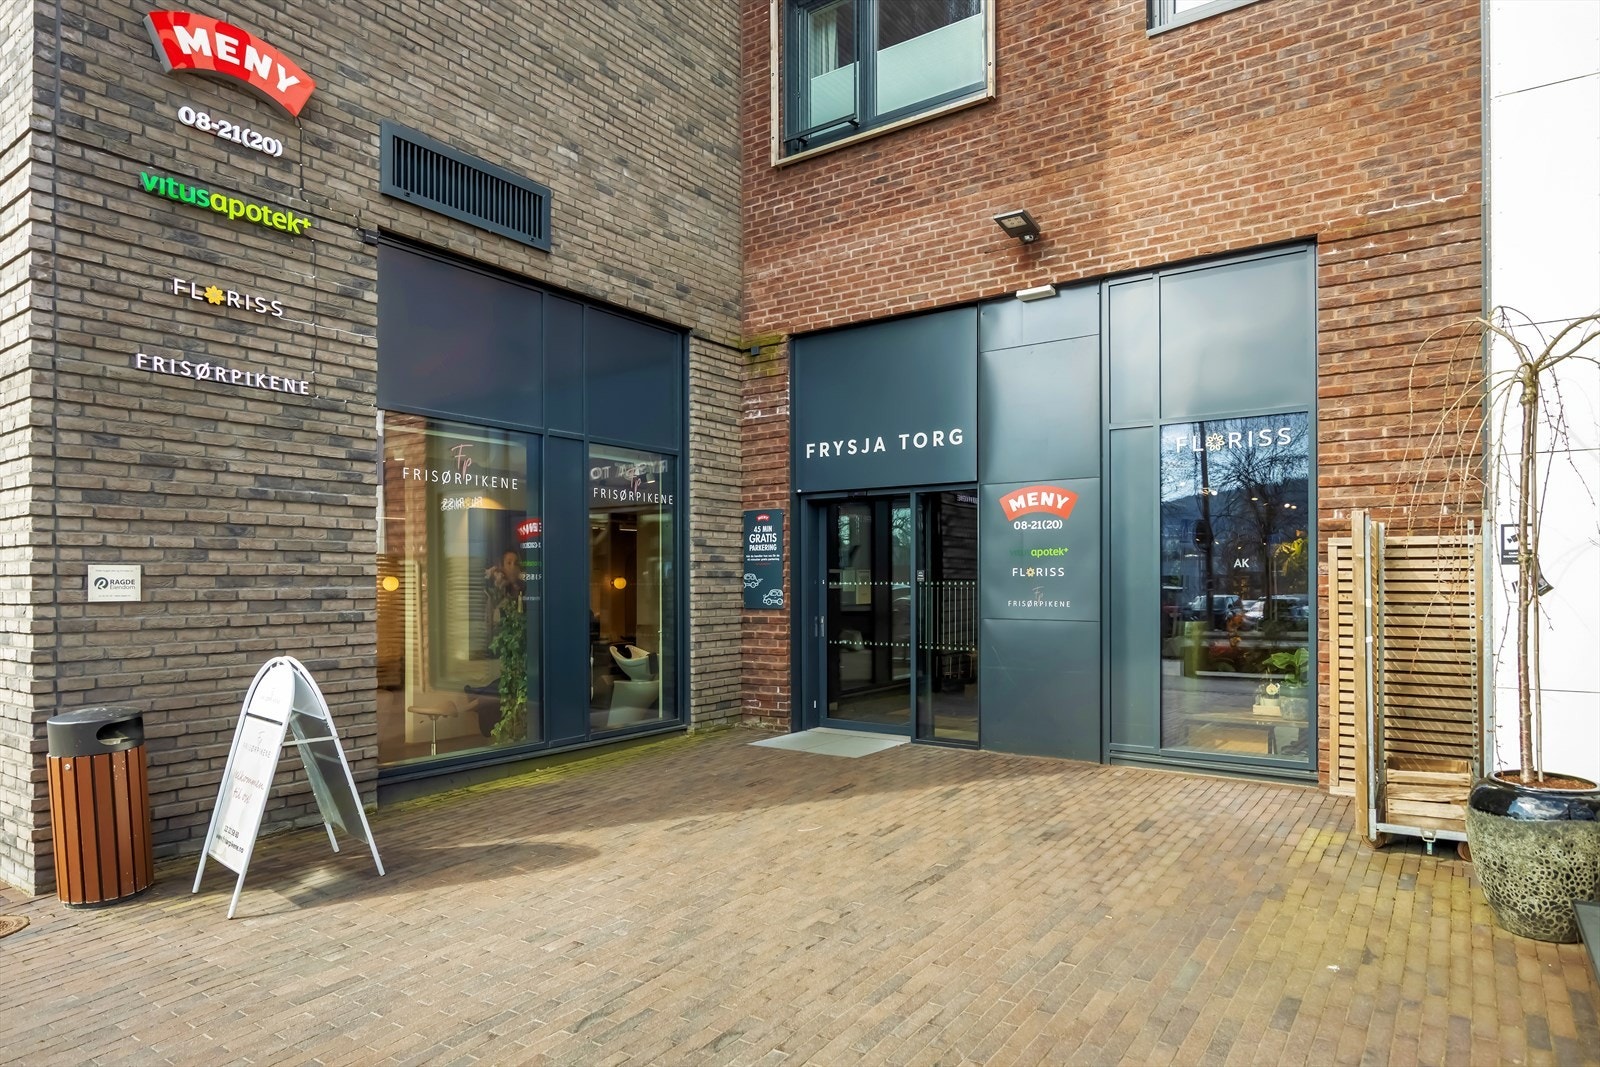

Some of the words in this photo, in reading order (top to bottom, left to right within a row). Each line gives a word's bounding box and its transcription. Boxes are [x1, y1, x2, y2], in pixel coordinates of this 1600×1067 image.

[173, 25, 300, 93] MENY
[177, 106, 283, 157] 08-21(20)
[136, 353, 309, 395] FRISØRPIKENE
[806, 437, 886, 458] FRYSJA
[899, 429, 963, 449] TORG
[402, 467, 518, 490] FRISØRPIKENE
[593, 487, 673, 505] FRISØRPIKENE
[1008, 491, 1070, 512] MENY
[762, 525, 773, 533] MIN
[1013, 520, 1063, 530] 08-21(20)
[749, 533, 777, 543] GRATIS
[749, 544, 777, 552] PARKERING
[1233, 558, 1250, 568] AK
[1008, 600, 1071, 608] FRISØRPIKENE
